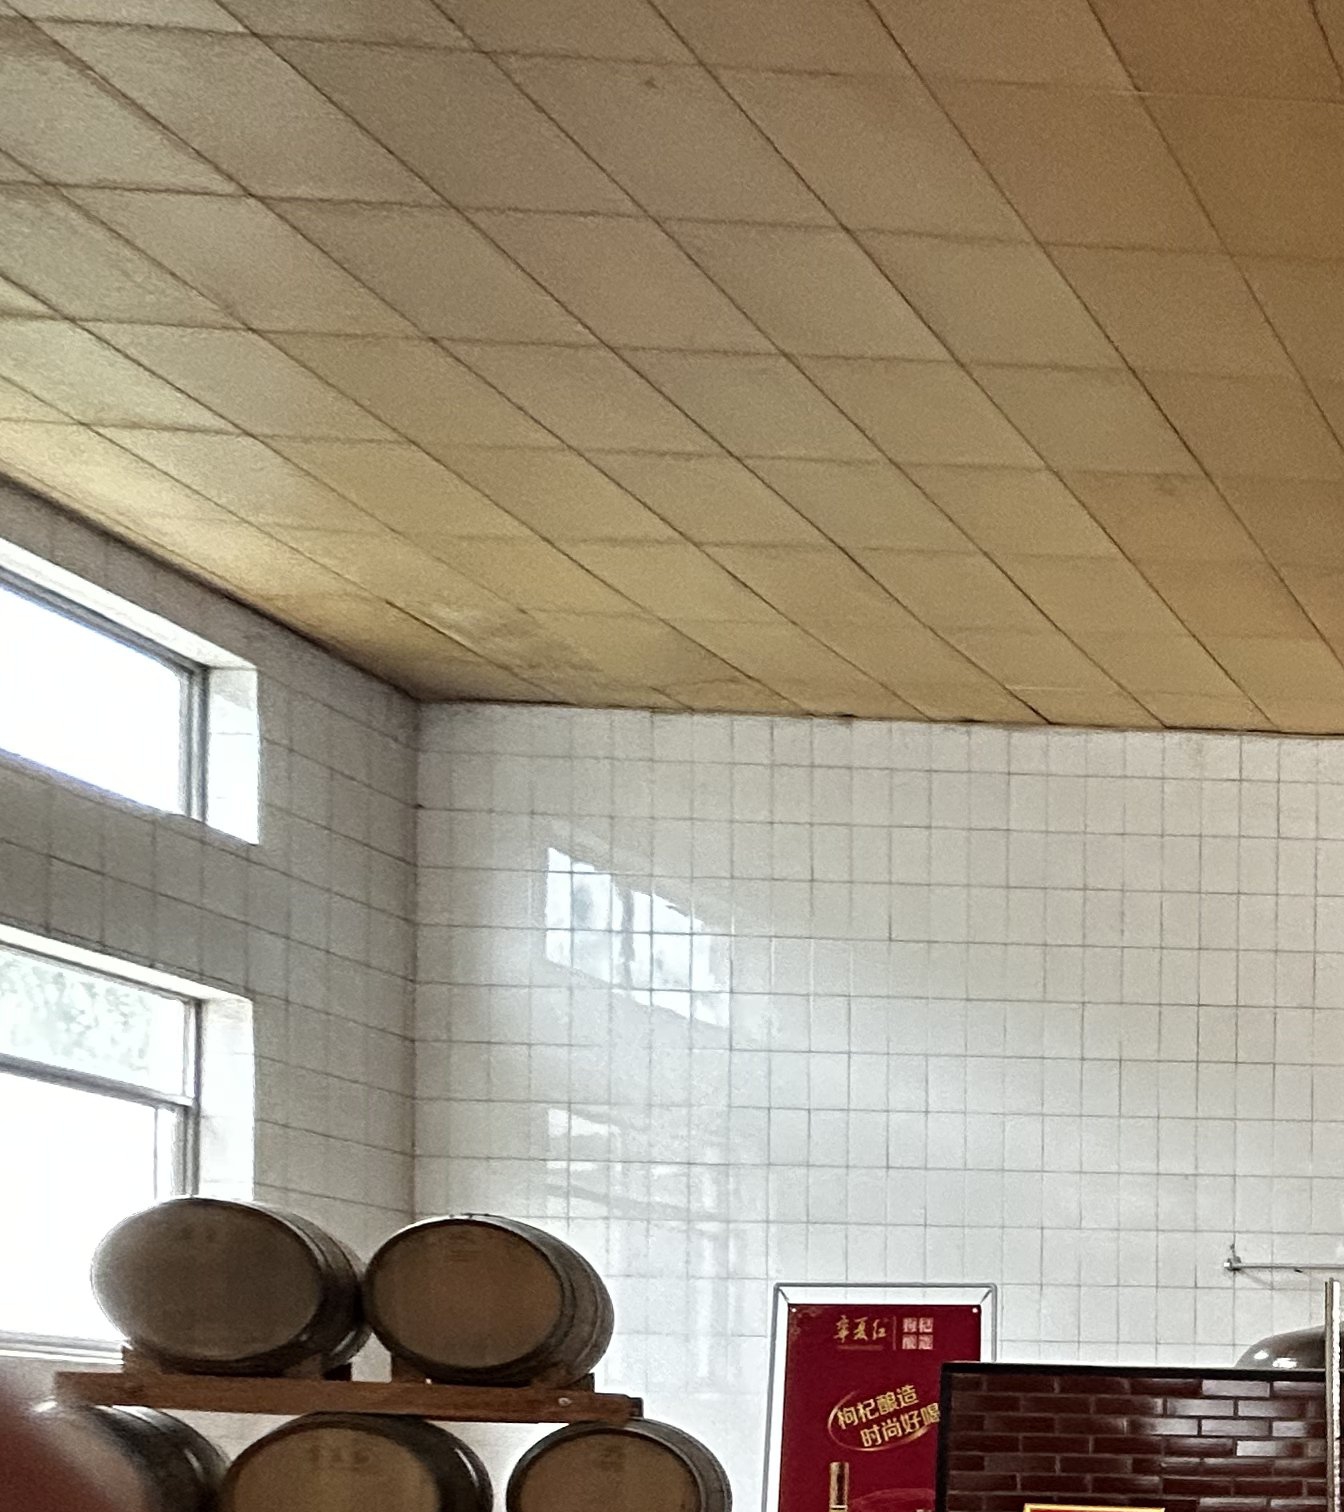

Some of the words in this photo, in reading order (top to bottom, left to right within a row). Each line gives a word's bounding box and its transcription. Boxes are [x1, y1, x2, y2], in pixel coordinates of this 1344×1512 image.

[837, 1384, 919, 1430] 枸杞酿造
[860, 1402, 940, 1447] 时尚好喝
